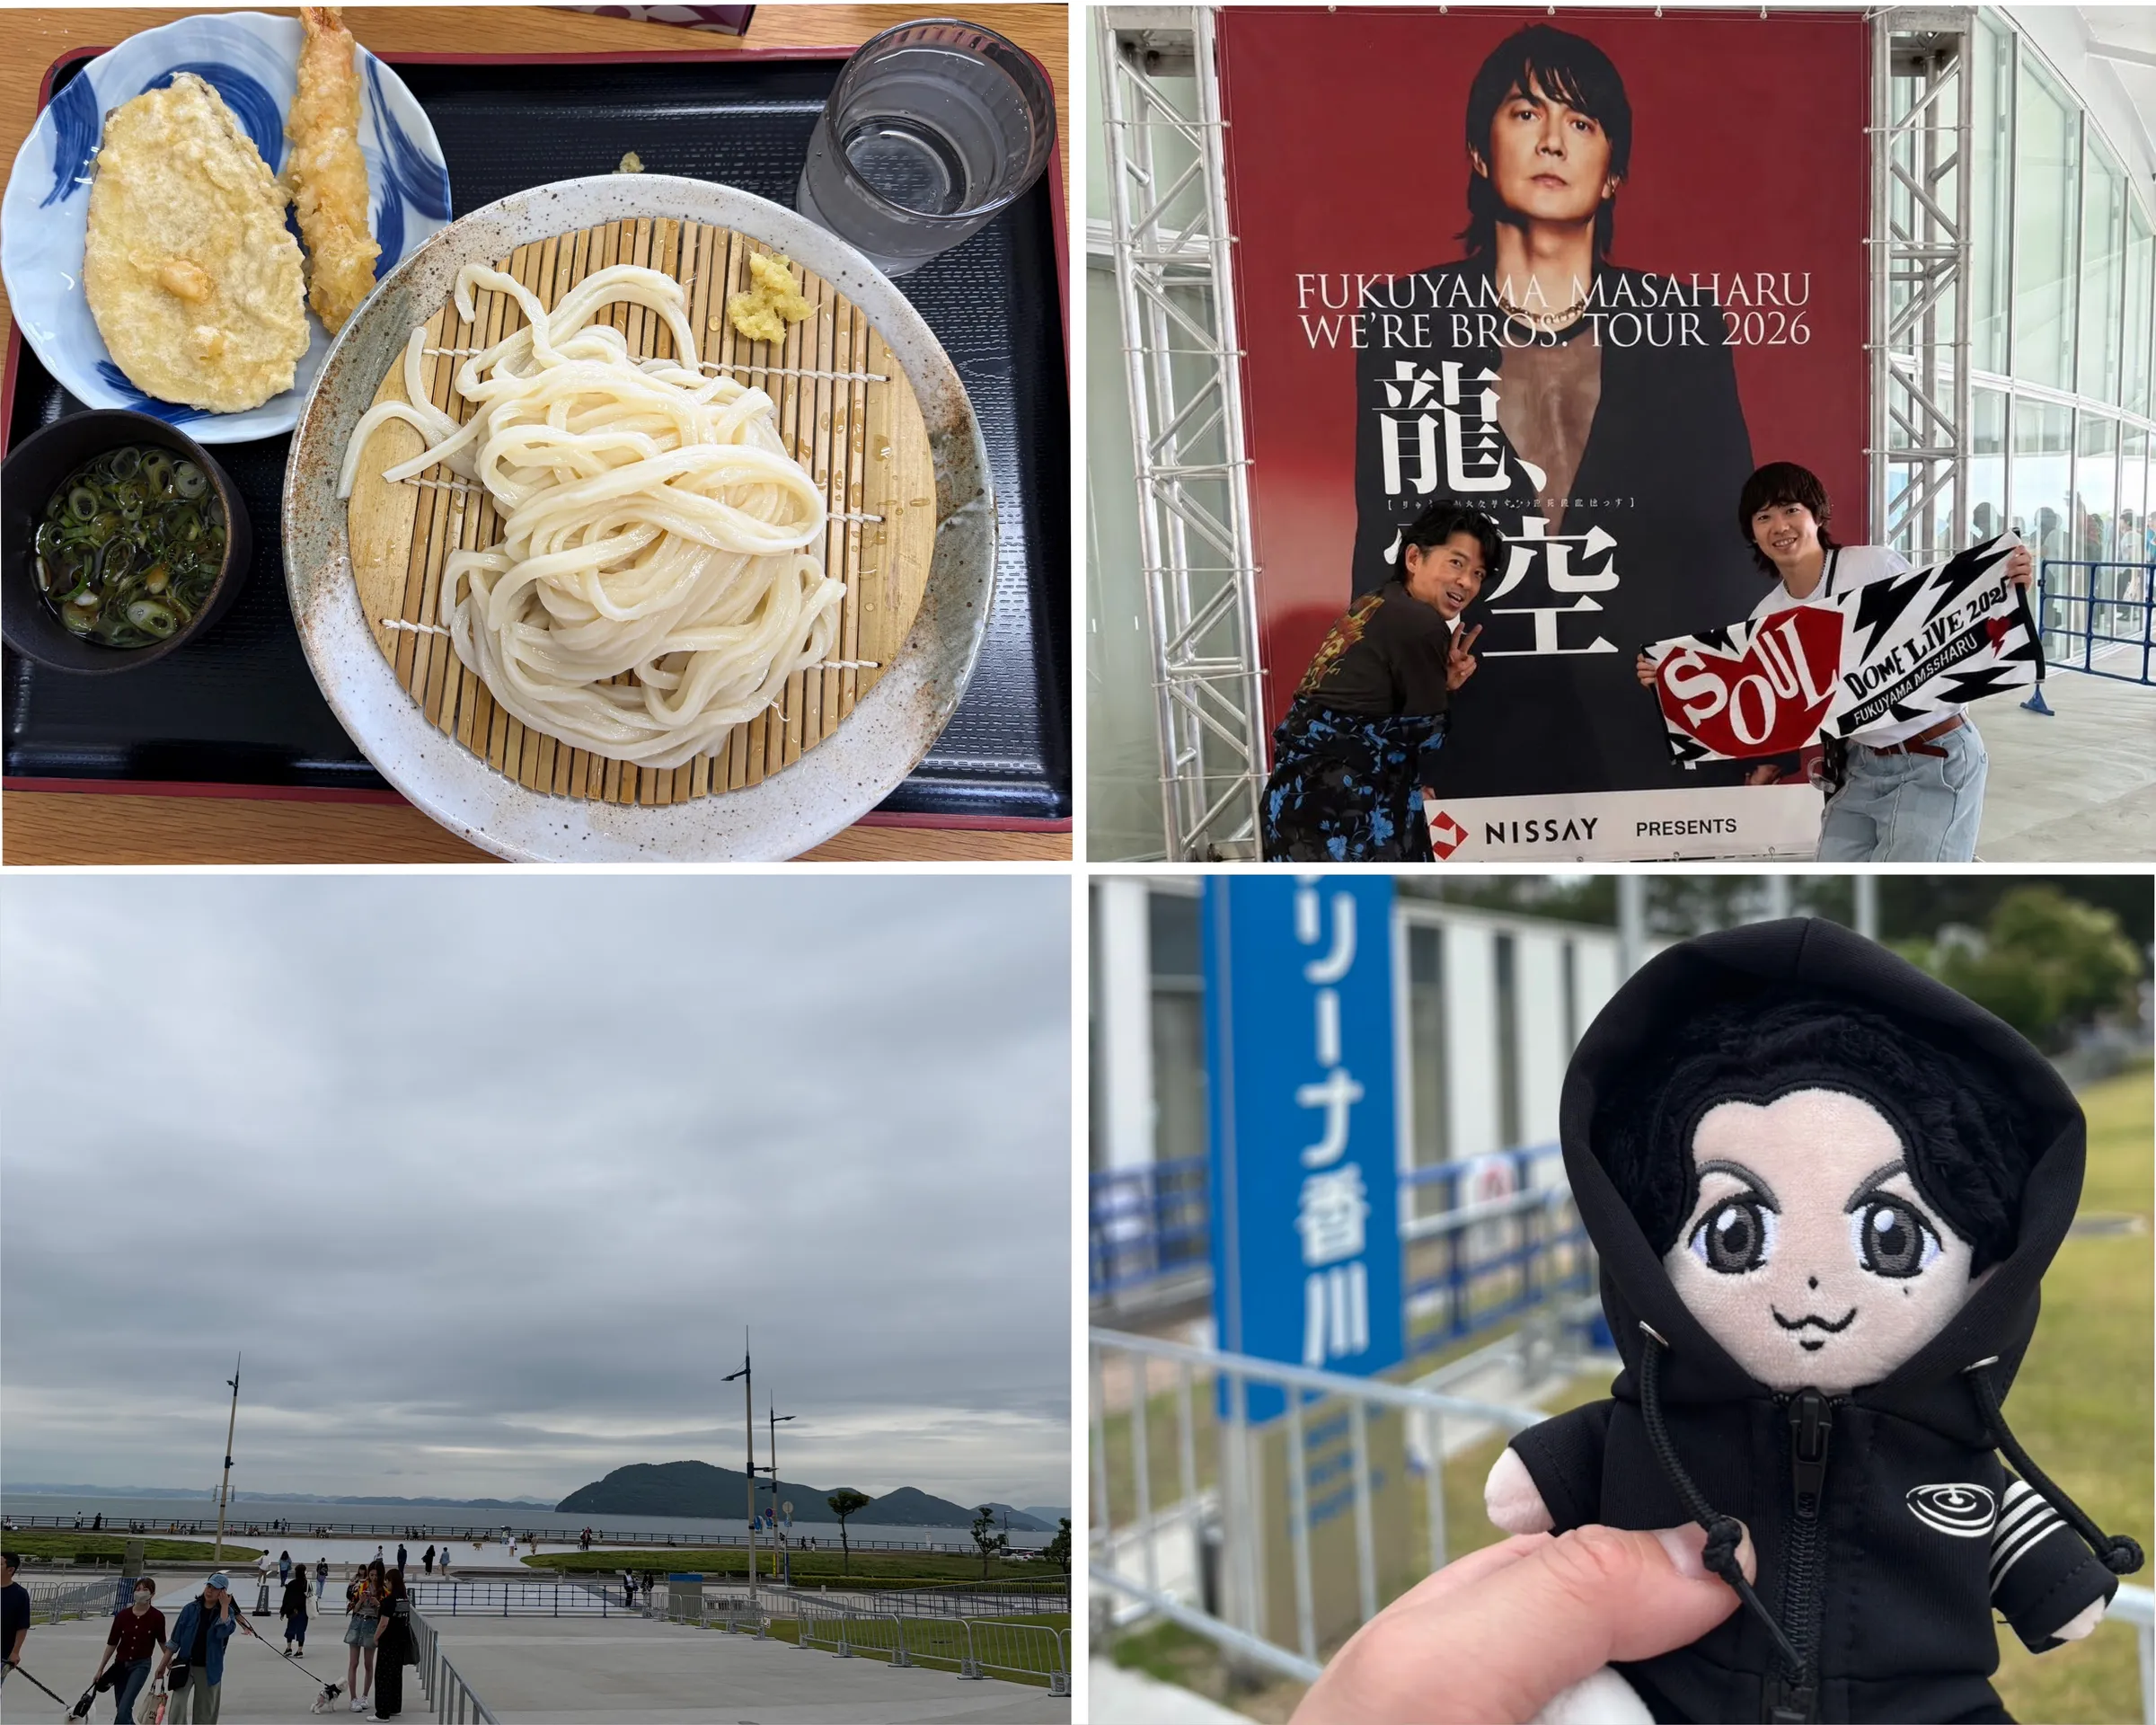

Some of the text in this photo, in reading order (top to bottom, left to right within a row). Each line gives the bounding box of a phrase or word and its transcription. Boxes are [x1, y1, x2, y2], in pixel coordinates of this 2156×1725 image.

[1296, 272, 1812, 310] FUKUYAMA MASAHARU
[1451, 314, 1568, 349] BROS.
[1582, 312, 1710, 349] TOUR
[1721, 310, 1812, 347] 2026
[1843, 646, 1905, 702] DOME
[1904, 609, 1966, 666] LIVE
[1664, 614, 1839, 745] SOUL
[1853, 680, 1913, 726] FUKUYAMA
[1485, 817, 1737, 845] NISSAY PRESENTS
[1294, 875, 1370, 1367] リーナ香川
